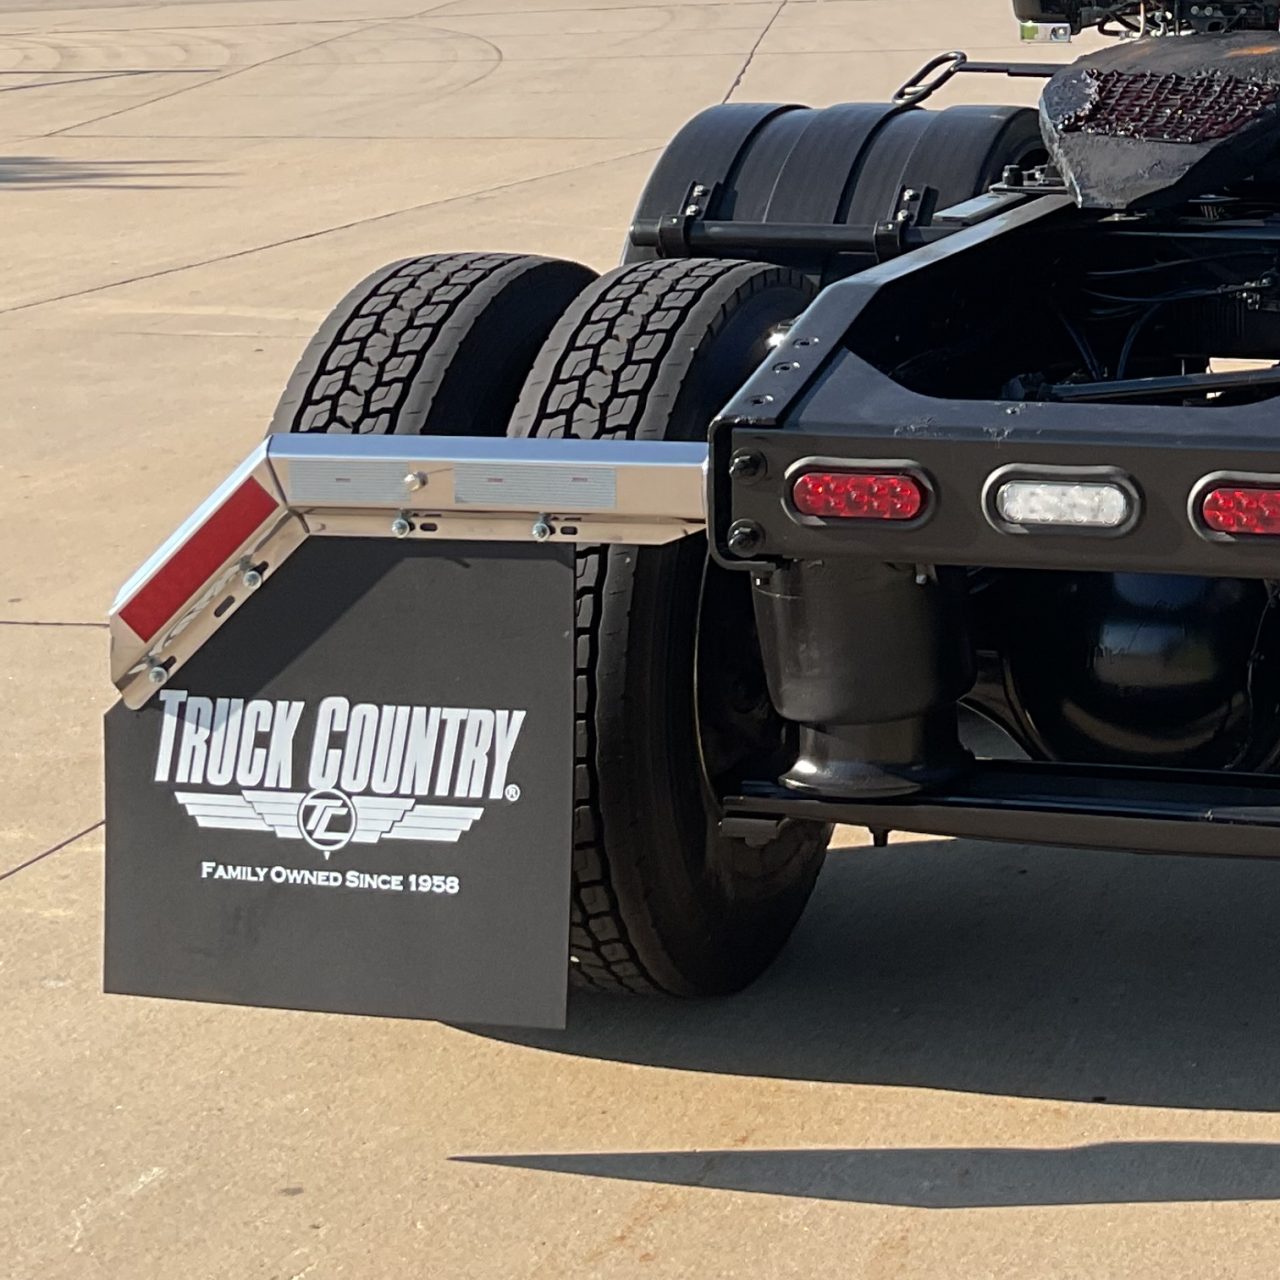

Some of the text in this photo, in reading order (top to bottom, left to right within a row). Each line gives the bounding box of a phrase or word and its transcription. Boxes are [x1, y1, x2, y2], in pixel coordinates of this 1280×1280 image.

[154, 690, 305, 789] TRUCK
[201, 861, 460, 895] FAMILY OWNED SINCE 1958
